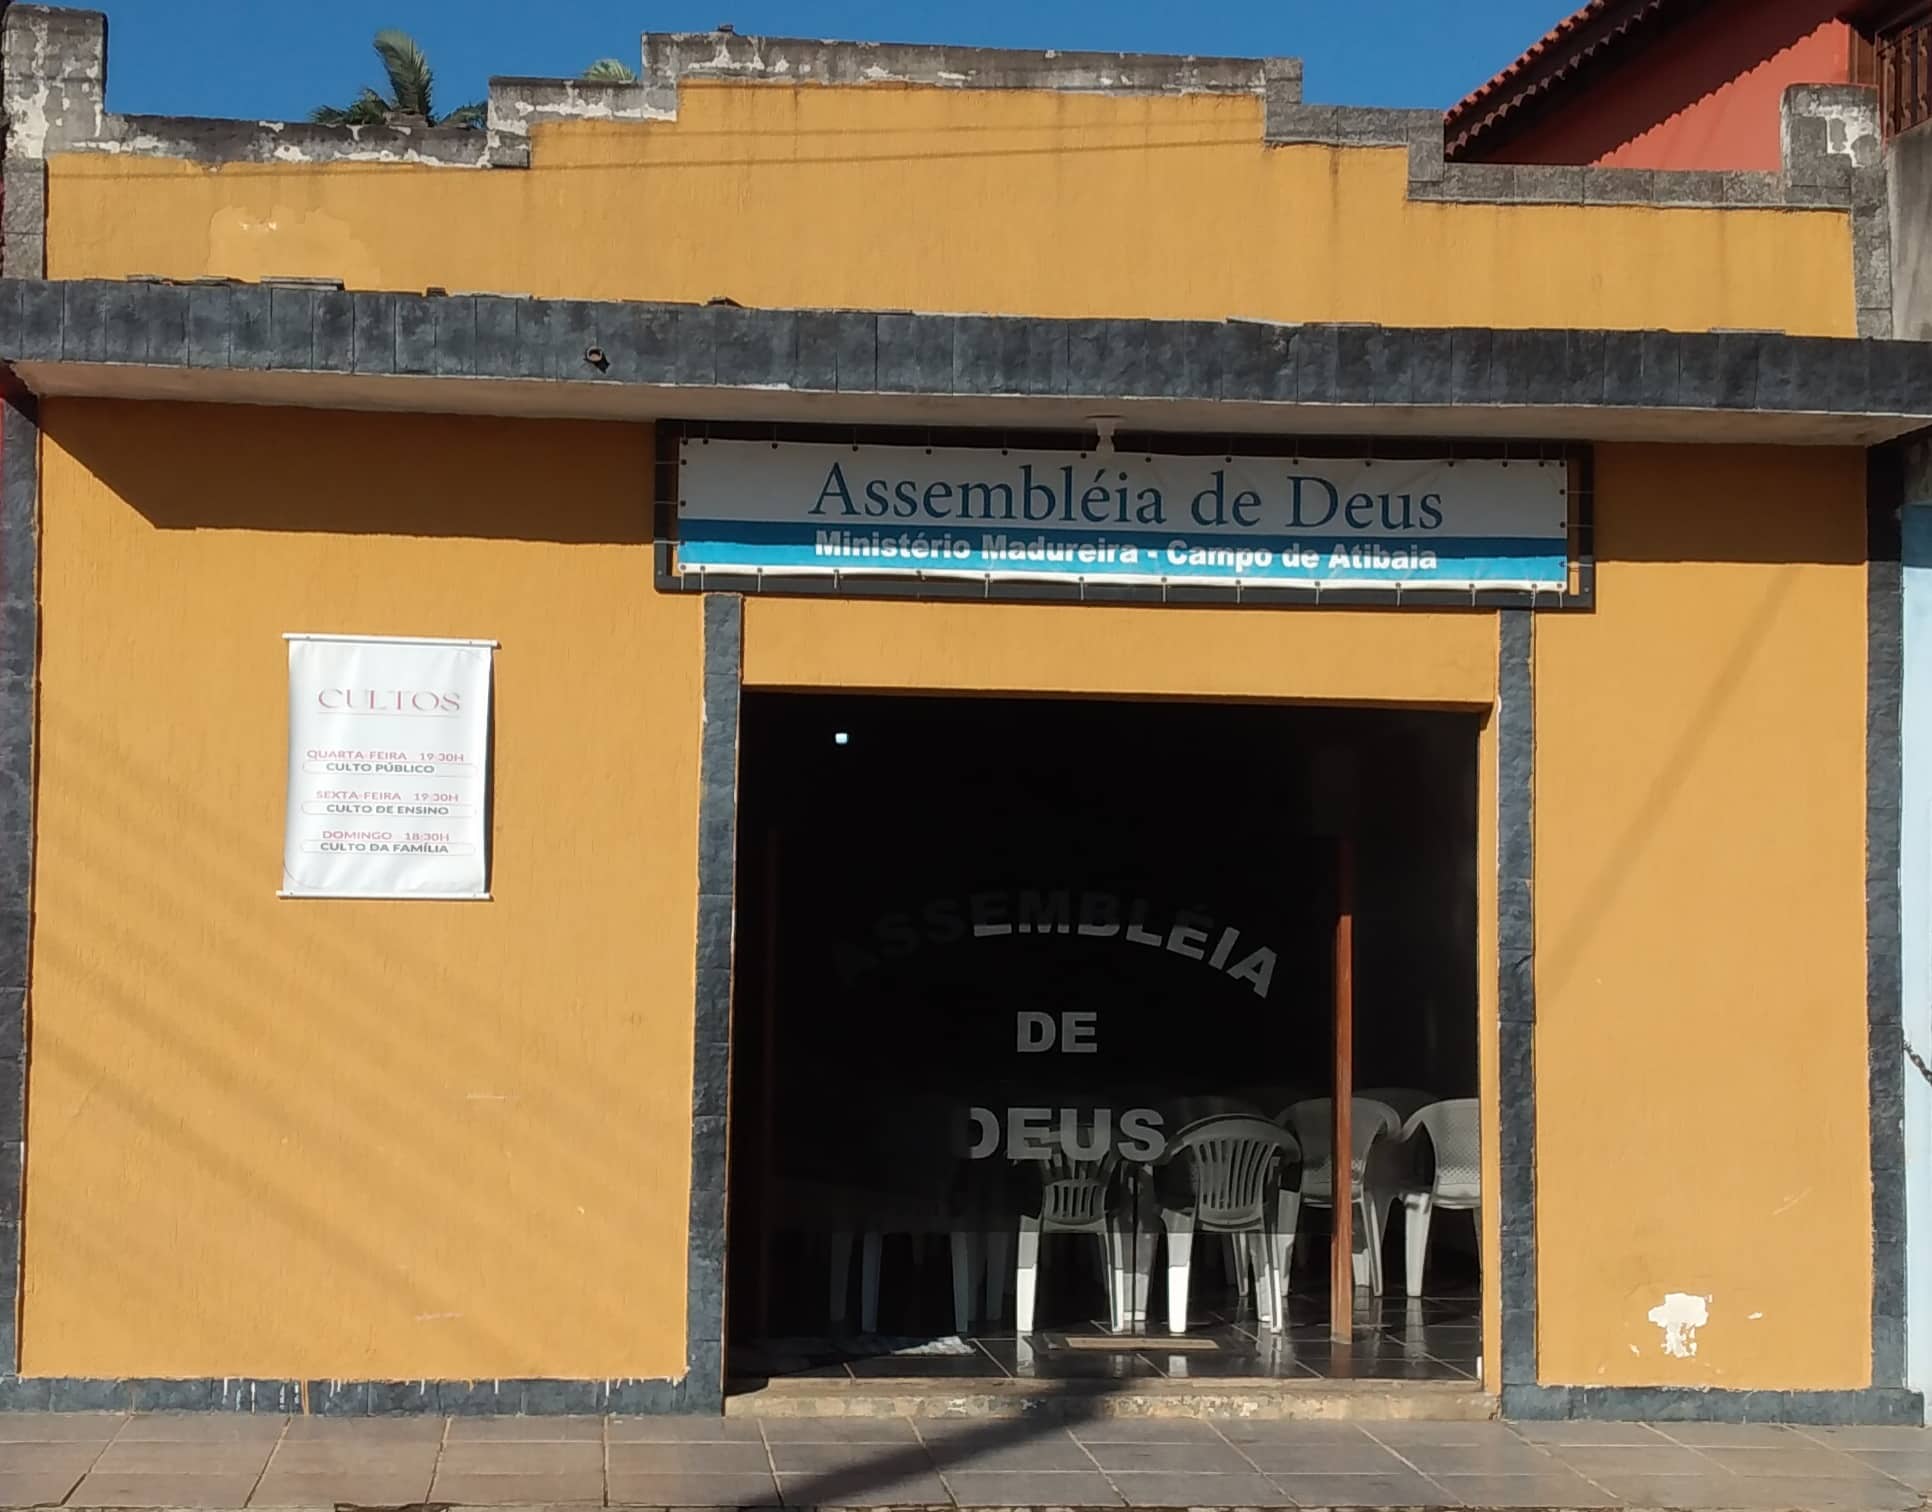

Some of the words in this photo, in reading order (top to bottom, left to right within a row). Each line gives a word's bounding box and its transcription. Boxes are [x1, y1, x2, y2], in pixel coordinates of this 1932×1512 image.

[808, 462, 1167, 524] Assembléia
[1191, 470, 1262, 527] de
[1285, 475, 1443, 530] Deus
[815, 530, 971, 560] Ministério
[981, 533, 1138, 564] Madureira
[1167, 539, 1272, 573] Campo
[1282, 543, 1320, 569] de
[1328, 544, 1438, 570] Atibaia
[318, 688, 461, 713] CULTOS
[306, 749, 408, 761] QUARTA-FEIRA
[326, 763, 372, 773] CULTO
[375, 762, 435, 774] PÚBLICO
[316, 790, 402, 801] SEXTA-FEIRA
[326, 804, 372, 814] CULTO
[376, 805, 394, 815] DE
[397, 805, 449, 816] ENSINO
[322, 830, 393, 841] DOMINGO
[320, 842, 366, 852] CULTO
[369, 842, 390, 853] DA
[393, 841, 449, 854] FAMÍLIA
[832, 888, 1278, 998] ASSEMBLÉIA
[1016, 1011, 1098, 1054] DE
[960, 1106, 1168, 1162] DEUS
